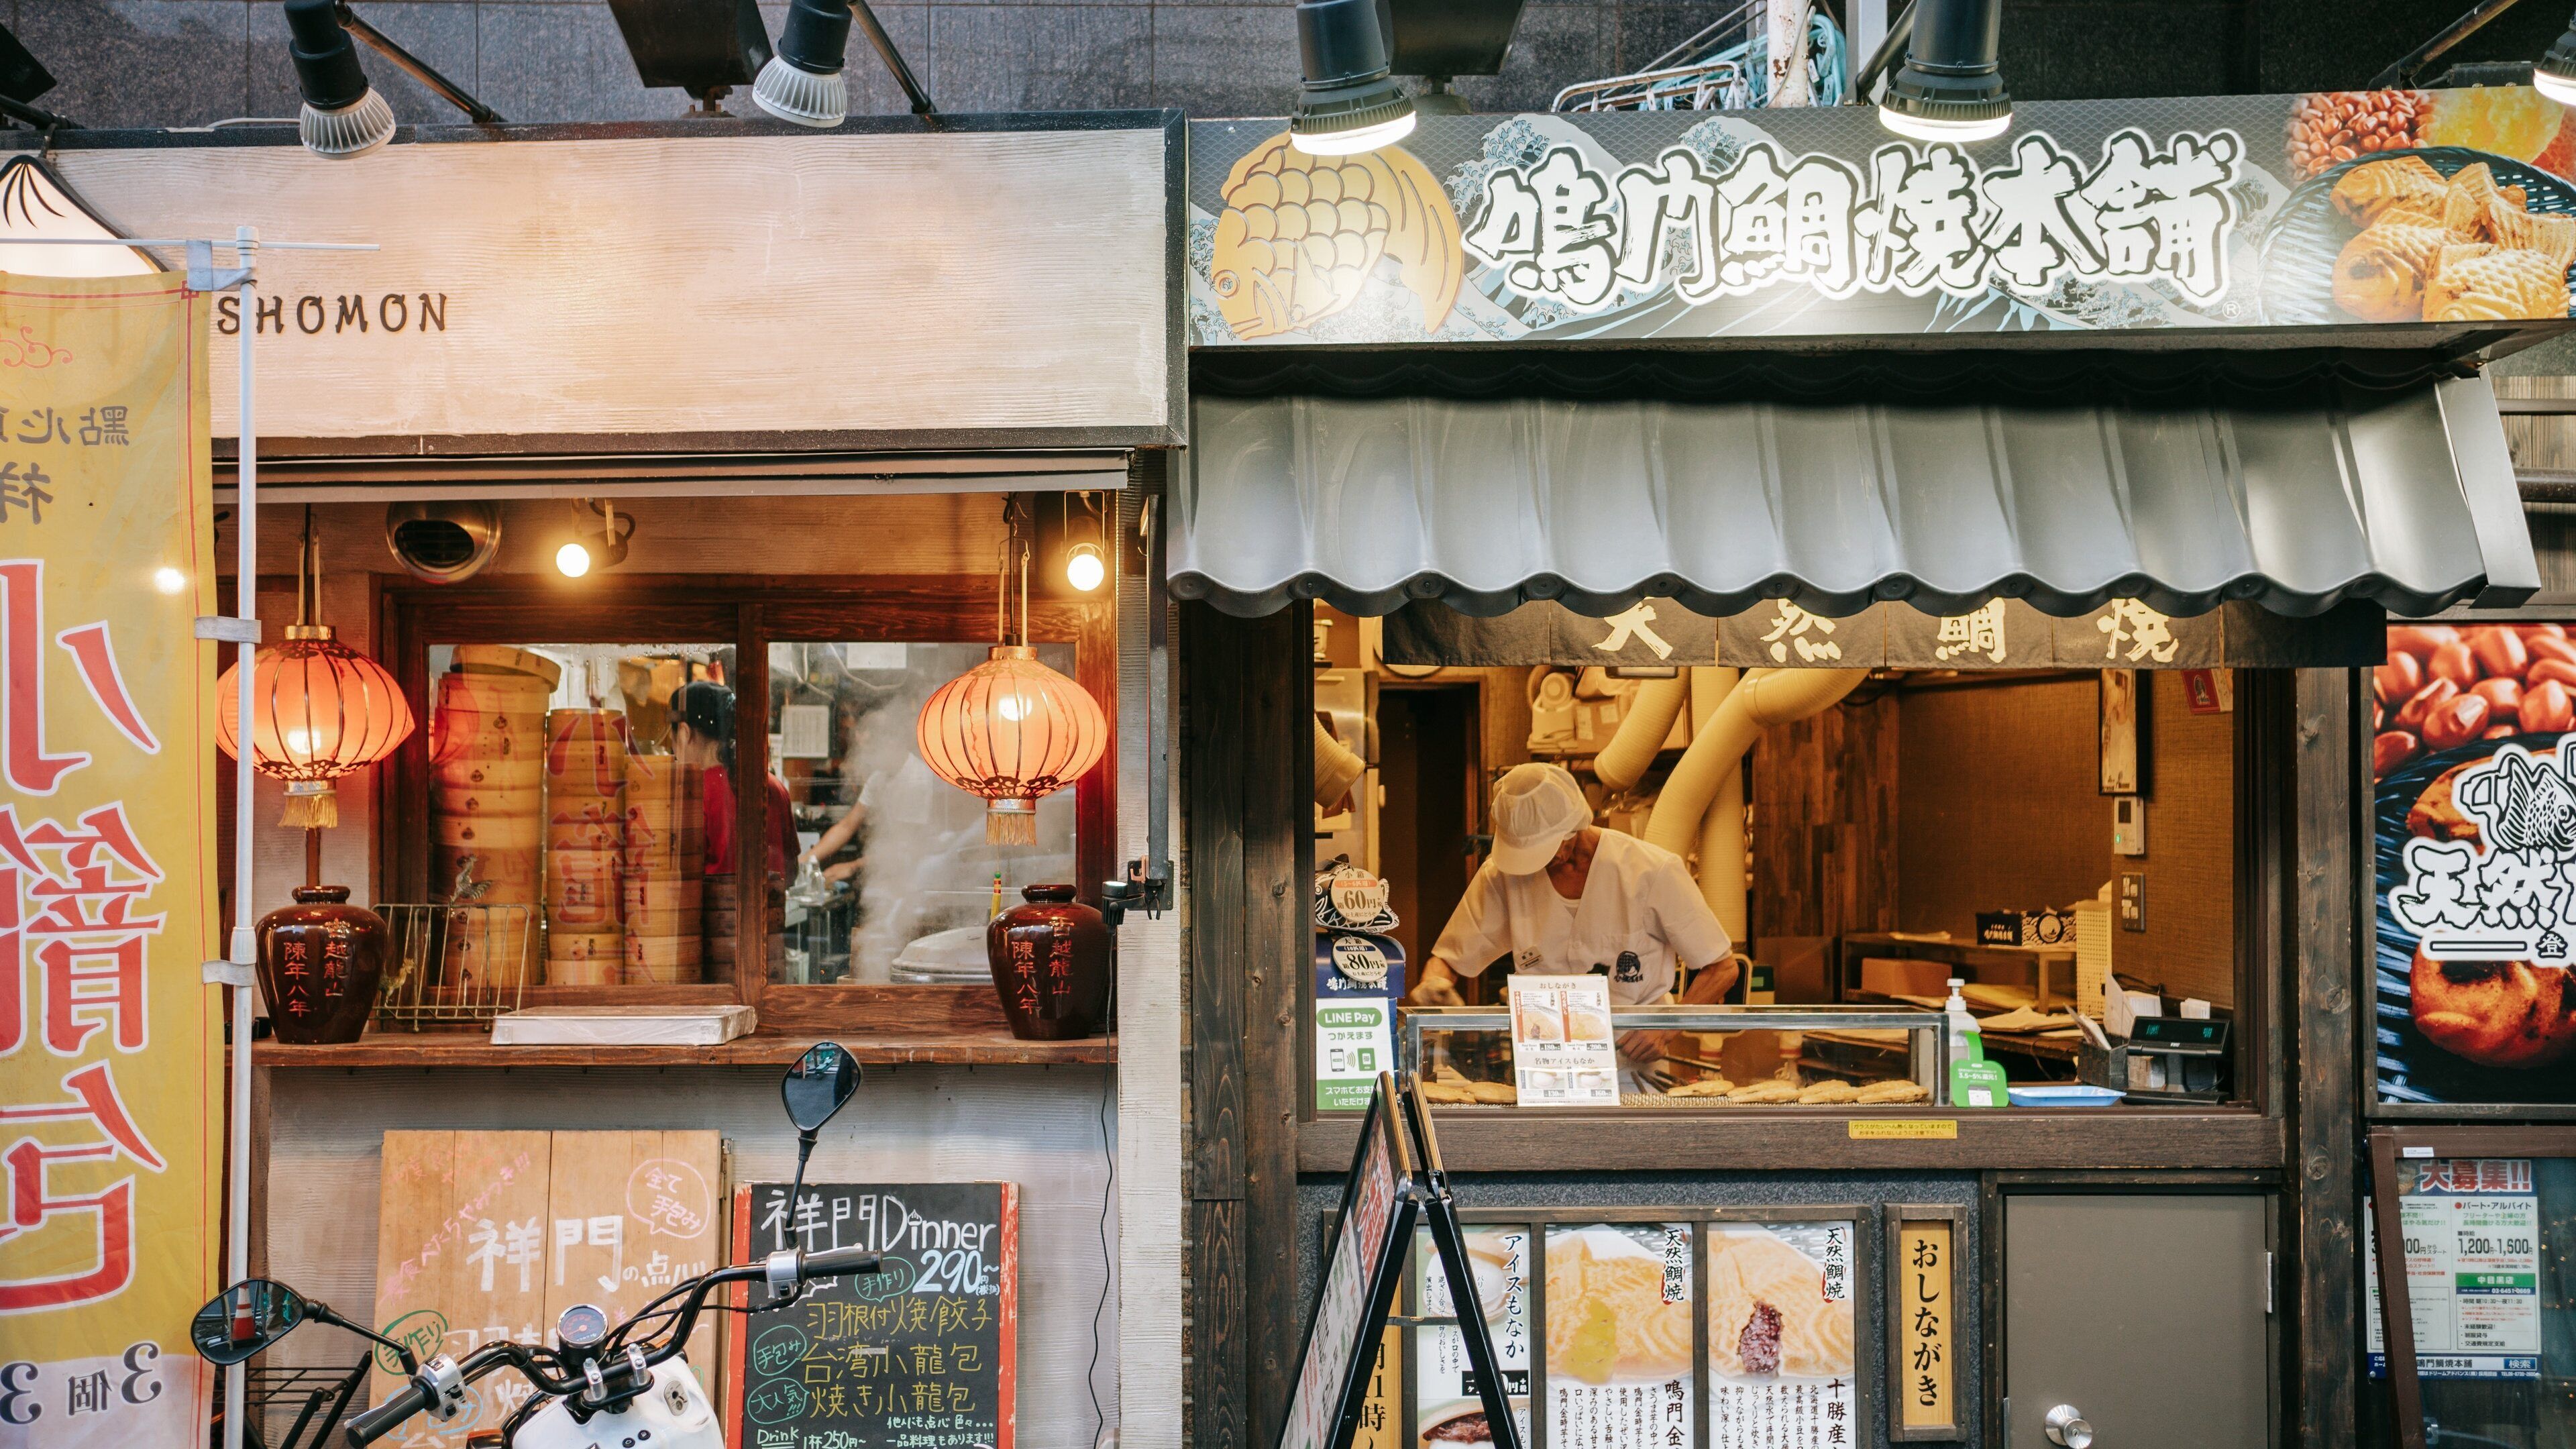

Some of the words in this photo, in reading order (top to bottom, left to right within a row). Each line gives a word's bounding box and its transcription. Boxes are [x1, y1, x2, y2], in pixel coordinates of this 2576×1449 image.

[217, 293, 448, 335] SHOMON
[2397, 844, 2576, 931] 天然
[1324, 1012, 1352, 1024] LINE
[1354, 1012, 1375, 1024] Pay
[1328, 1031, 1373, 1040] つかえます
[1534, 1057, 1595, 1065] 名物アイスもなか
[2420, 1159, 2532, 1193] 大募集!!
[862, 1267, 905, 1298] 手作り
[1664, 1227, 1685, 1303] 天然鯛焼
[1824, 1227, 1845, 1300] 天然鯛焼
[1502, 1233, 1525, 1359] アイスもなか
[1912, 1239, 1941, 1407] おしながき
[756, 1339, 802, 1370] 手包み
[2509, 1359, 2531, 1369] 検索
[809, 1382, 977, 1418] 焼き小龍包
[1665, 1379, 1693, 1449] 鳴門金
[1827, 1378, 1847, 1449] 十勝産
[756, 1426, 800, 1444] Drink
[1518, 1408, 1527, 1449] アイスも
